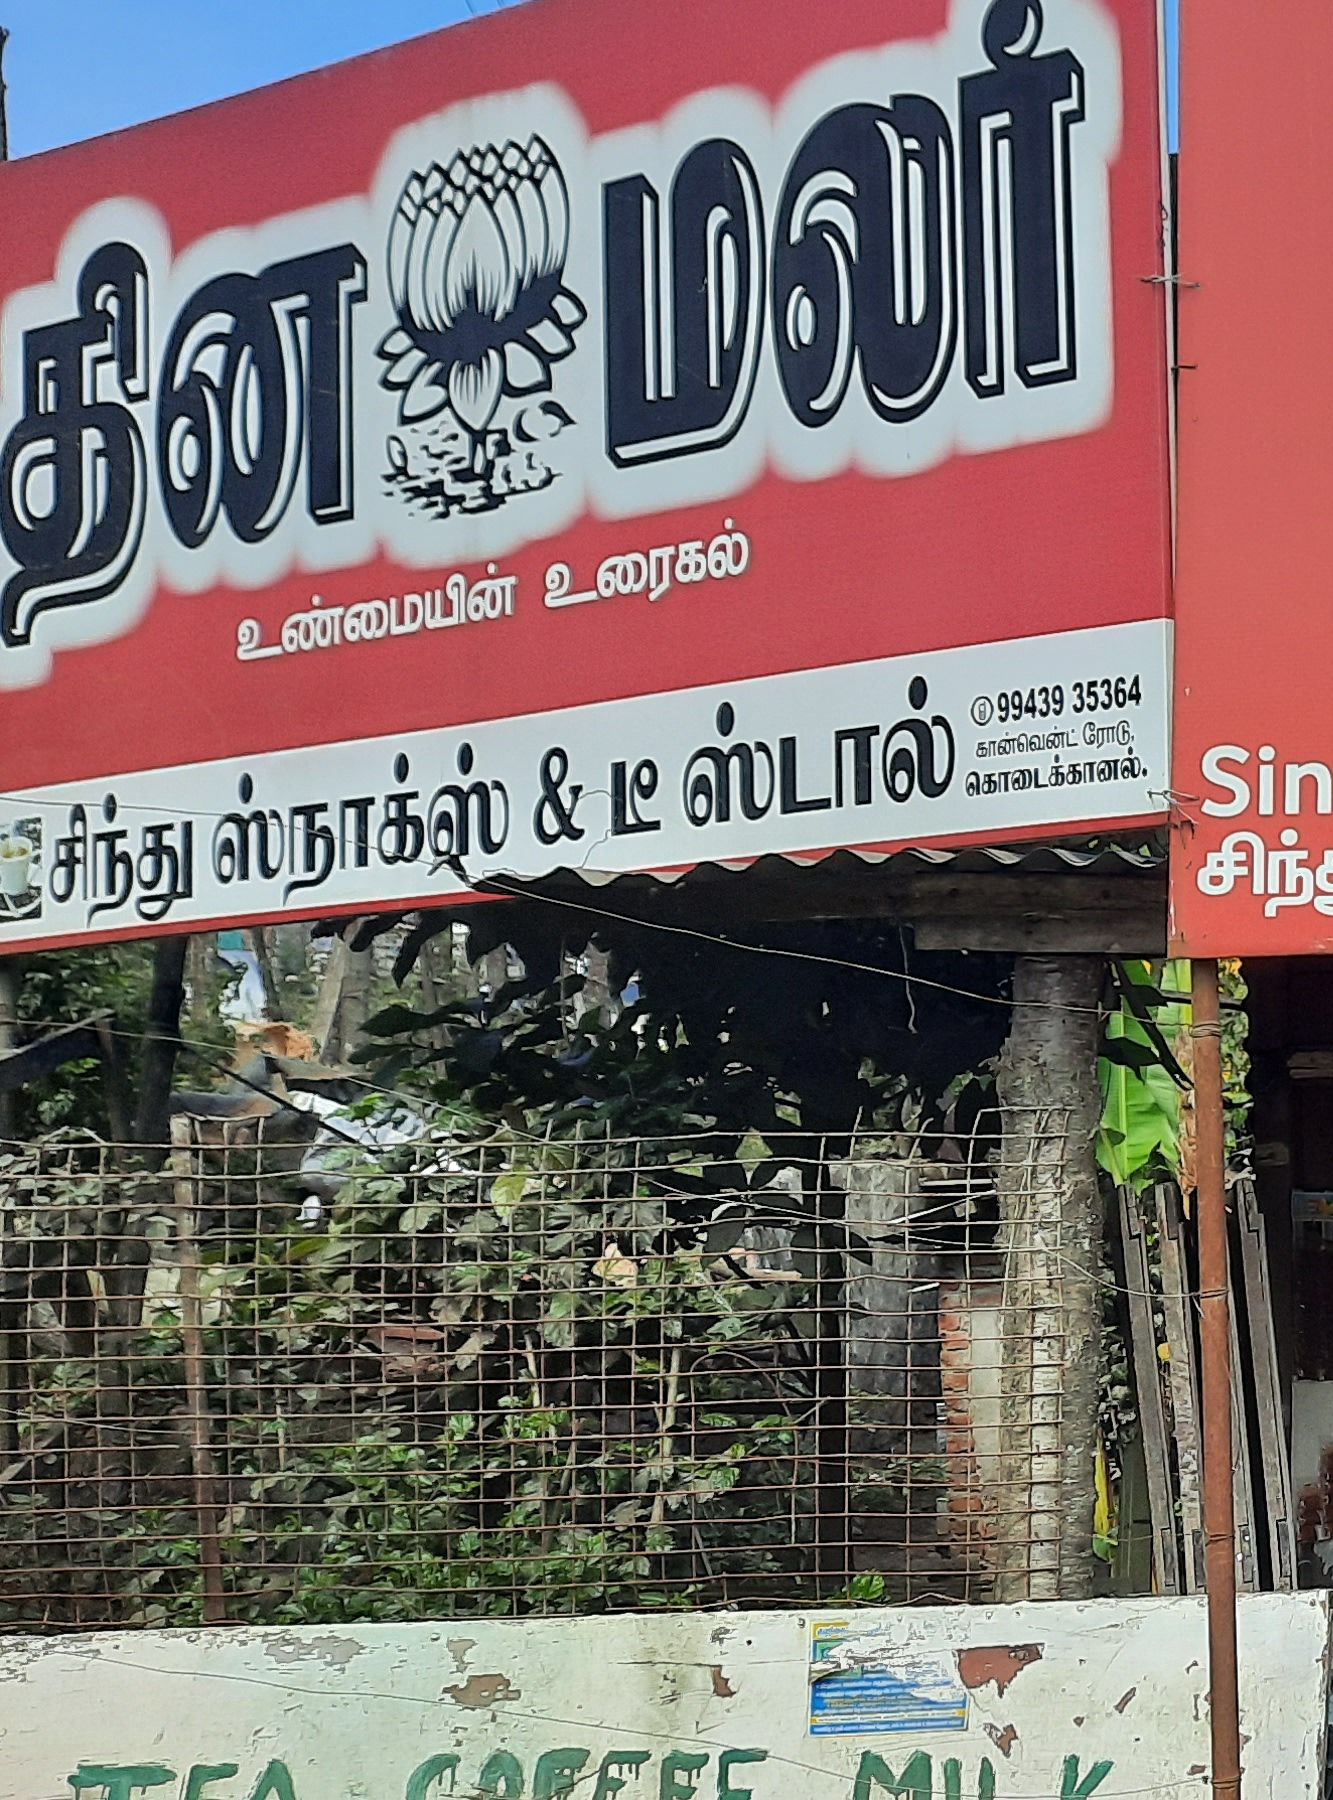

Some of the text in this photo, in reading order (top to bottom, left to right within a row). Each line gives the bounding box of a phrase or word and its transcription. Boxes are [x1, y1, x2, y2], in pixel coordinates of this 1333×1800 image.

[0, 0, 1085, 648] தின மலர்
[236, 518, 749, 661] உண்மையின் உரைகல்
[998, 674, 1142, 723] 99439 35364
[50, 675, 955, 927] சிந்து ஸ்நாக்ஸ் & டீ ஸ்டால்
